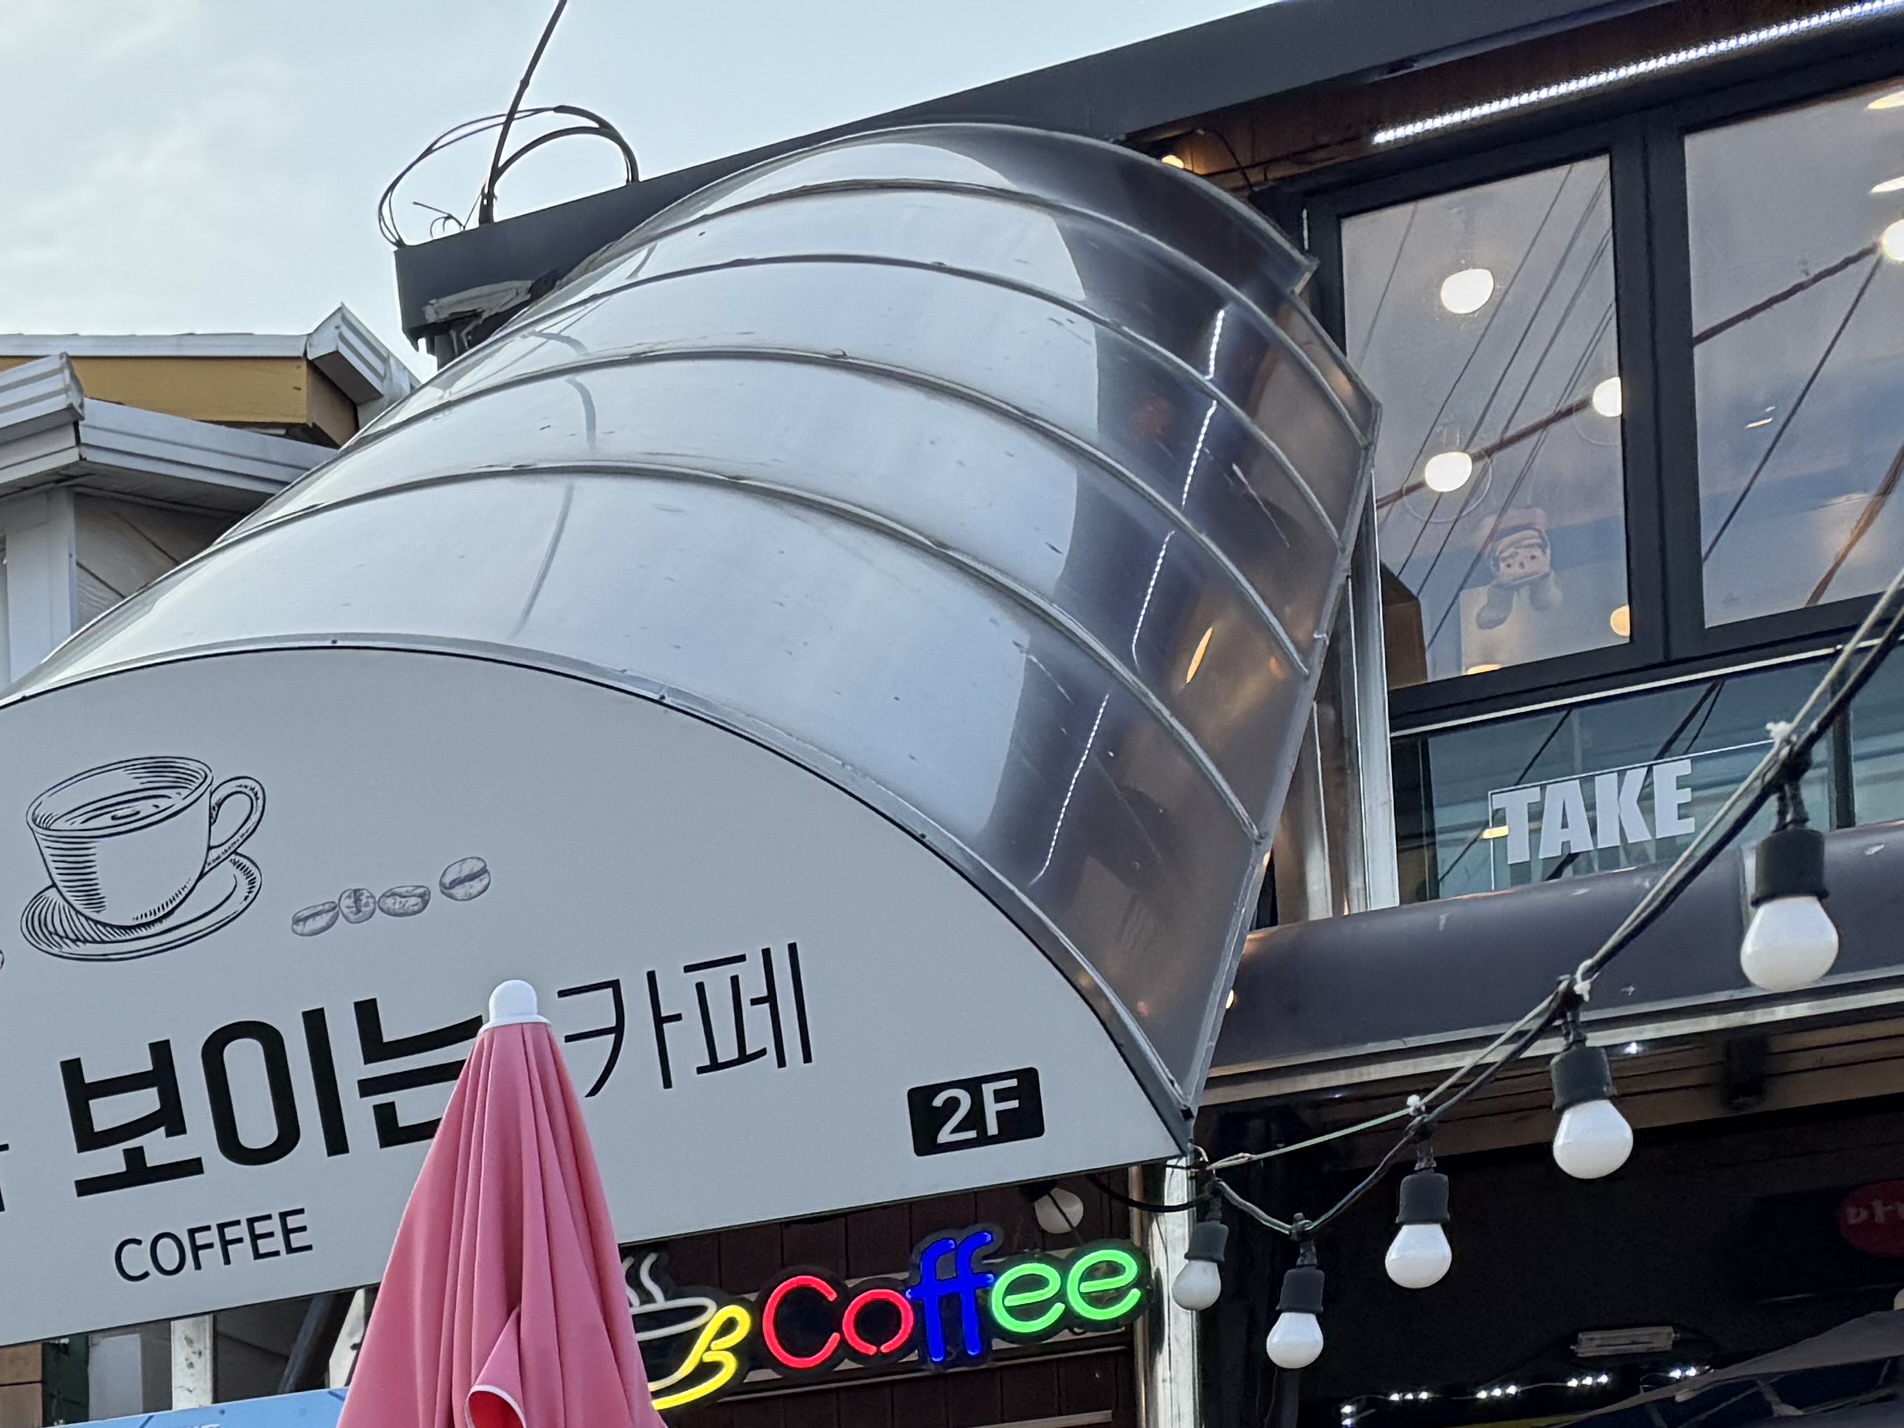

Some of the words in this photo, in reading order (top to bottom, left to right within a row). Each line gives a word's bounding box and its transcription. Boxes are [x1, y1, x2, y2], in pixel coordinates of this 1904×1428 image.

[1492, 757, 1695, 865] TAKE
[58, 997, 484, 1199] 보이는
[556, 941, 813, 1099] 카페
[930, 1083, 1023, 1154] 2F
[113, 1207, 316, 1284] COFFEE
[761, 1230, 1142, 1371] Coffee
